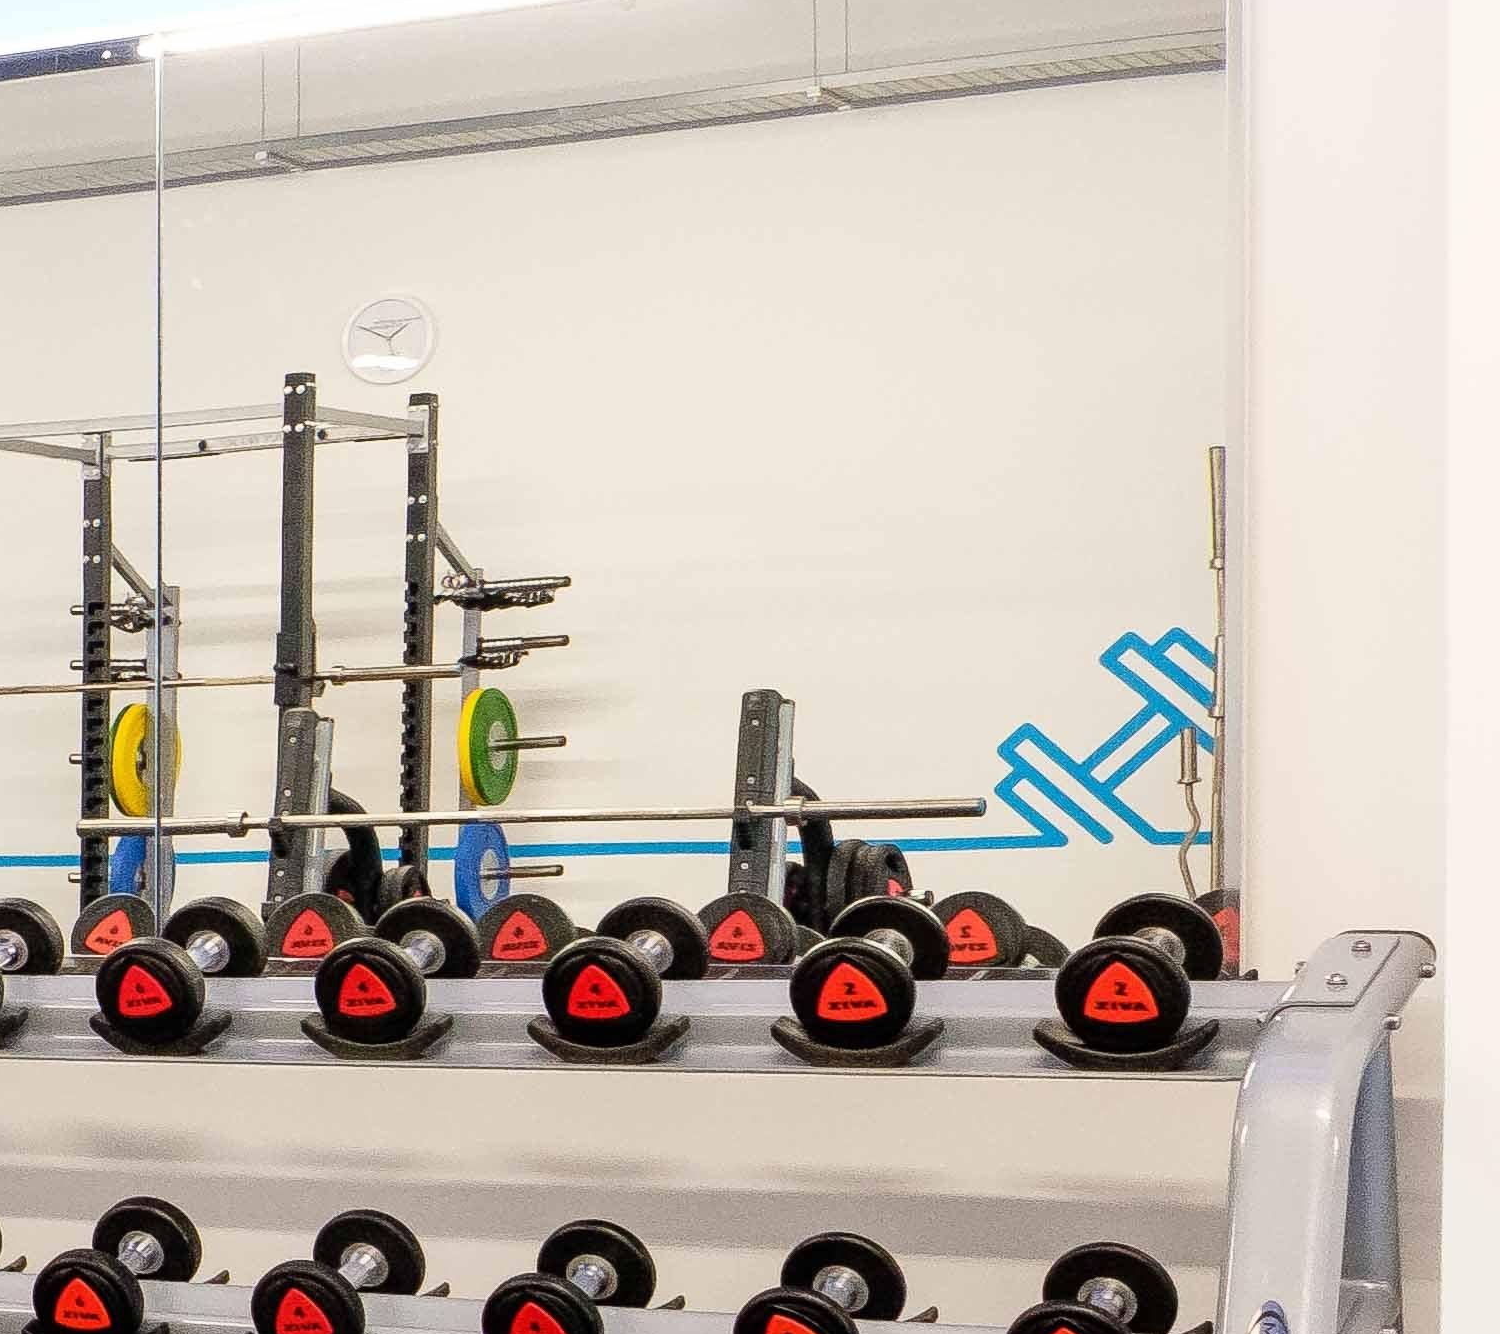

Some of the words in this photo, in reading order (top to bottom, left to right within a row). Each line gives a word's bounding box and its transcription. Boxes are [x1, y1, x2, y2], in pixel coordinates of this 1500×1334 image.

[136, 983, 145, 993] 6
[844, 982, 855, 995] 2
[1114, 982, 1127, 996] 2
[828, 1000, 877, 1011] ZIVA
[1094, 1001, 1149, 1012] ZIVA
